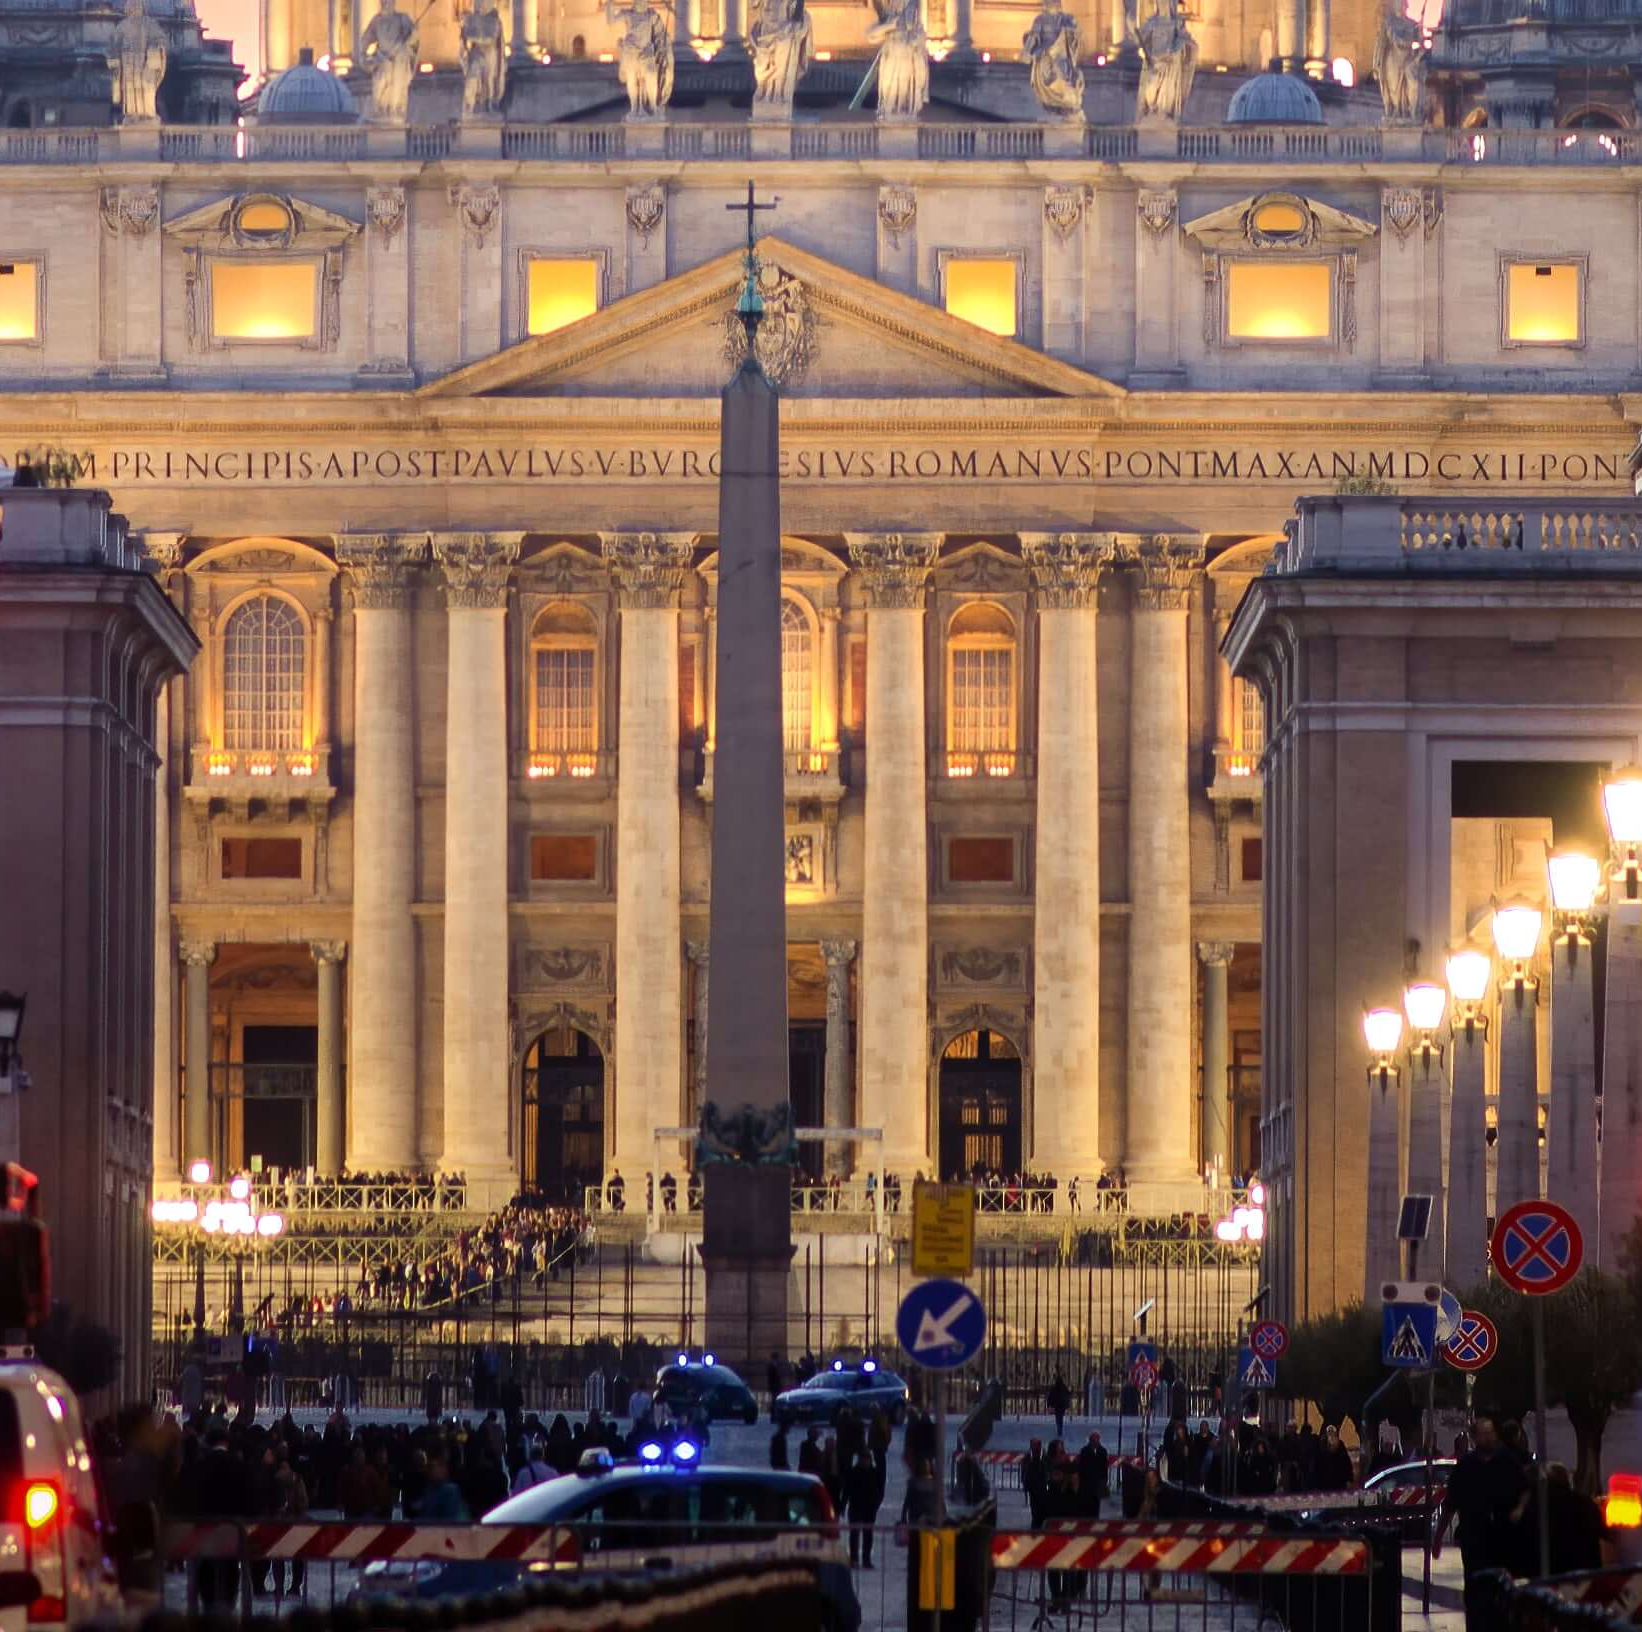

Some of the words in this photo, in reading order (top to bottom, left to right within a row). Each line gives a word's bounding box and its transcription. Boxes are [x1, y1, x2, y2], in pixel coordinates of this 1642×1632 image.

[111, 451, 312, 480] PRINCIPIS
[323, 450, 446, 479] APOST
[453, 450, 584, 478] PAVLVS
[595, 450, 617, 476] V
[889, 450, 1092, 479] ROMANVS
[1105, 450, 1206, 479] PONT
[1212, 451, 1295, 479] MAX
[1305, 451, 1355, 479] AN
[1369, 451, 1526, 481] MDCXII
